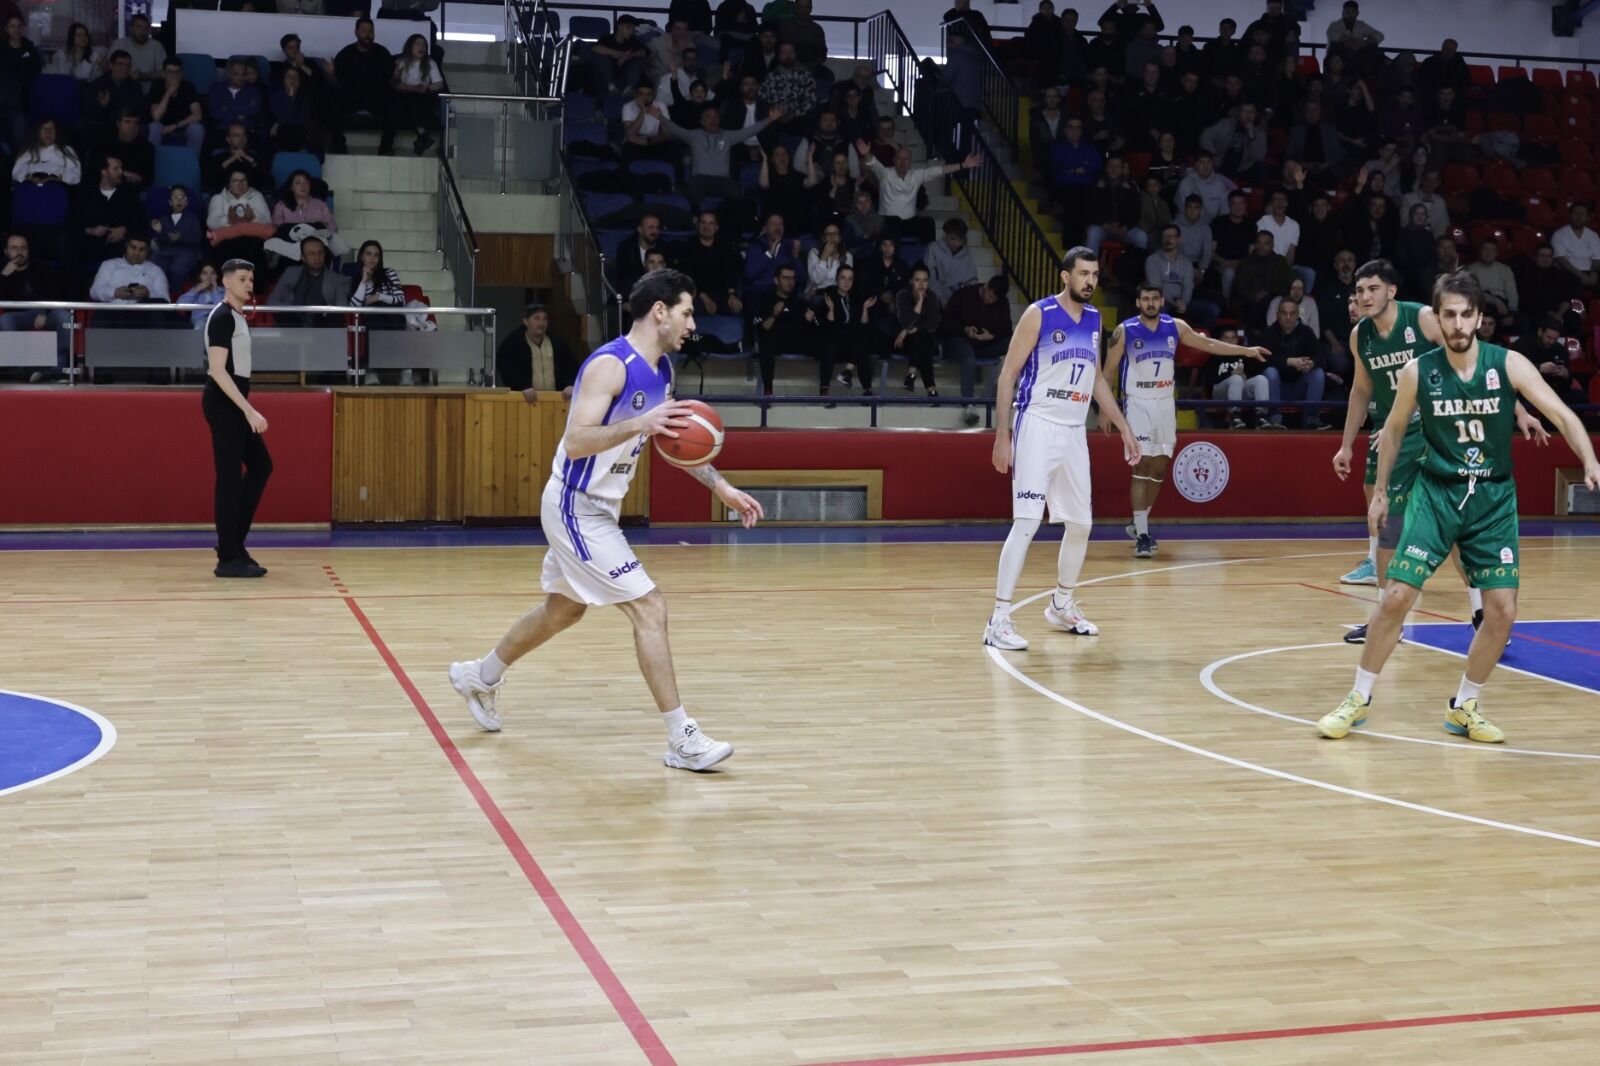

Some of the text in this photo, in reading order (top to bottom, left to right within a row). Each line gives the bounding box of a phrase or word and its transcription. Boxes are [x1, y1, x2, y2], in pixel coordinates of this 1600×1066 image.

[1152, 361, 1161, 377] 7
[1368, 349, 1415, 370] KARATAY
[1069, 363, 1086, 385] 17
[1386, 368, 1401, 390] 1
[1136, 379, 1174, 389] REFSAN
[1046, 388, 1090, 403] REFSAN
[1432, 397, 1501, 416] KARATAY
[1454, 419, 1485, 443] 10
[1016, 490, 1046, 501] sidera
